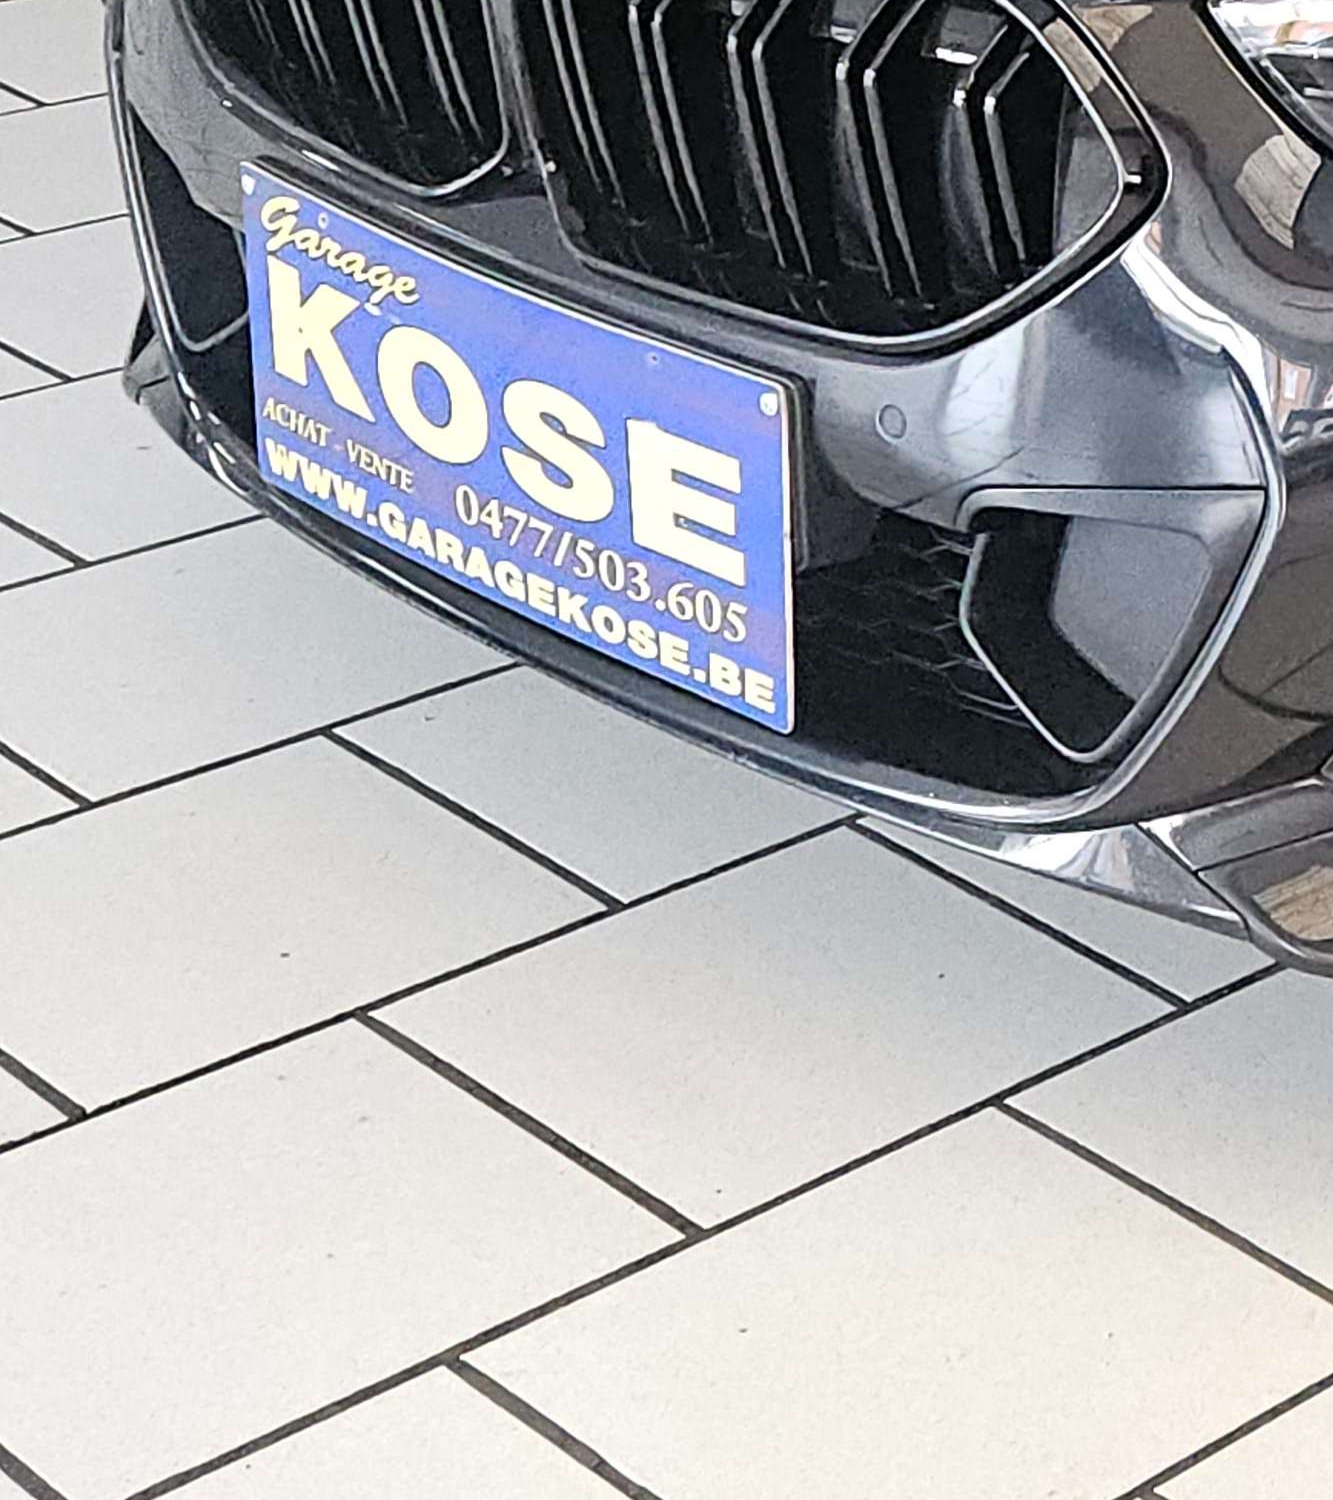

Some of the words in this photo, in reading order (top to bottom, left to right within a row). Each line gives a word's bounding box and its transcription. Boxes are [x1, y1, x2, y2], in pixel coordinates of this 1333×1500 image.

[259, 195, 419, 305] Garage
[262, 397, 334, 450] ACHAT
[346, 439, 414, 495] VENTE
[266, 254, 746, 587] KOSE
[264, 438, 776, 714] WWW.GARAGEKOSE.BE
[454, 484, 748, 643] 0477/503.605
